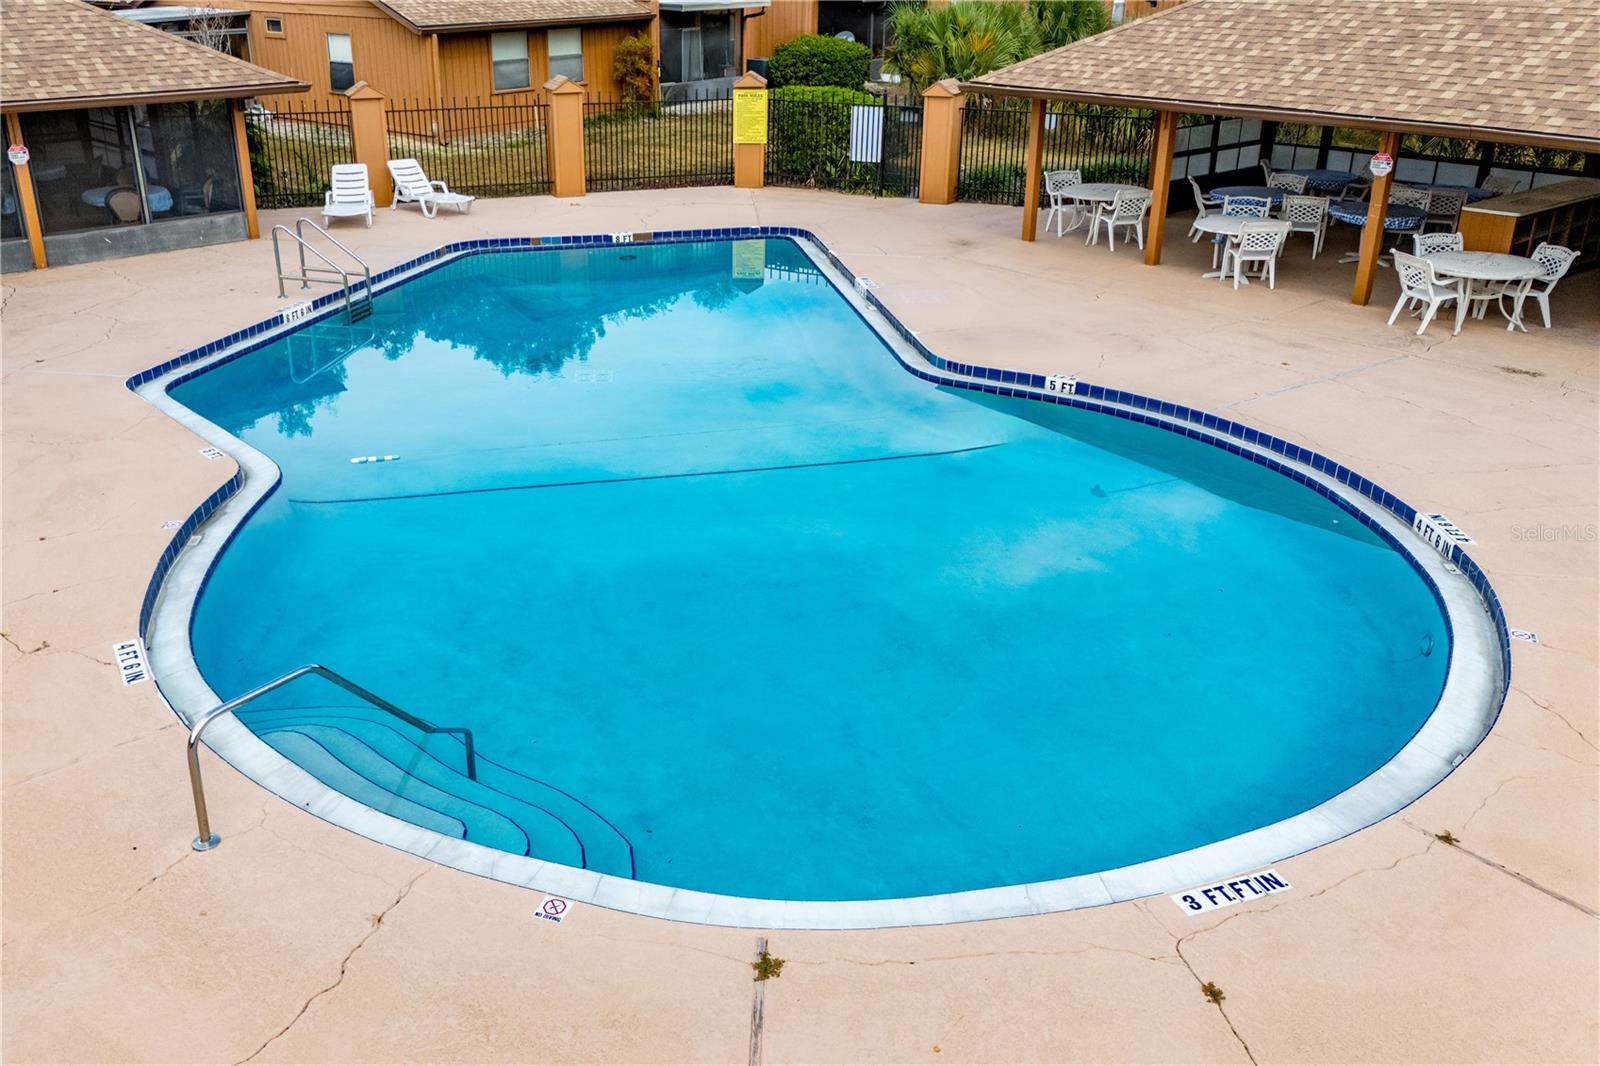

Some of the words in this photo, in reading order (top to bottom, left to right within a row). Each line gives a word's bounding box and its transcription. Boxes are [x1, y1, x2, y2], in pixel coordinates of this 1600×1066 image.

[1050, 380, 1057, 391] 5
[1416, 519, 1423, 533] 4
[1435, 534, 1442, 548] 6
[118, 643, 135, 651] 4
[123, 662, 141, 671] 6
[1181, 895, 1203, 911] 3
